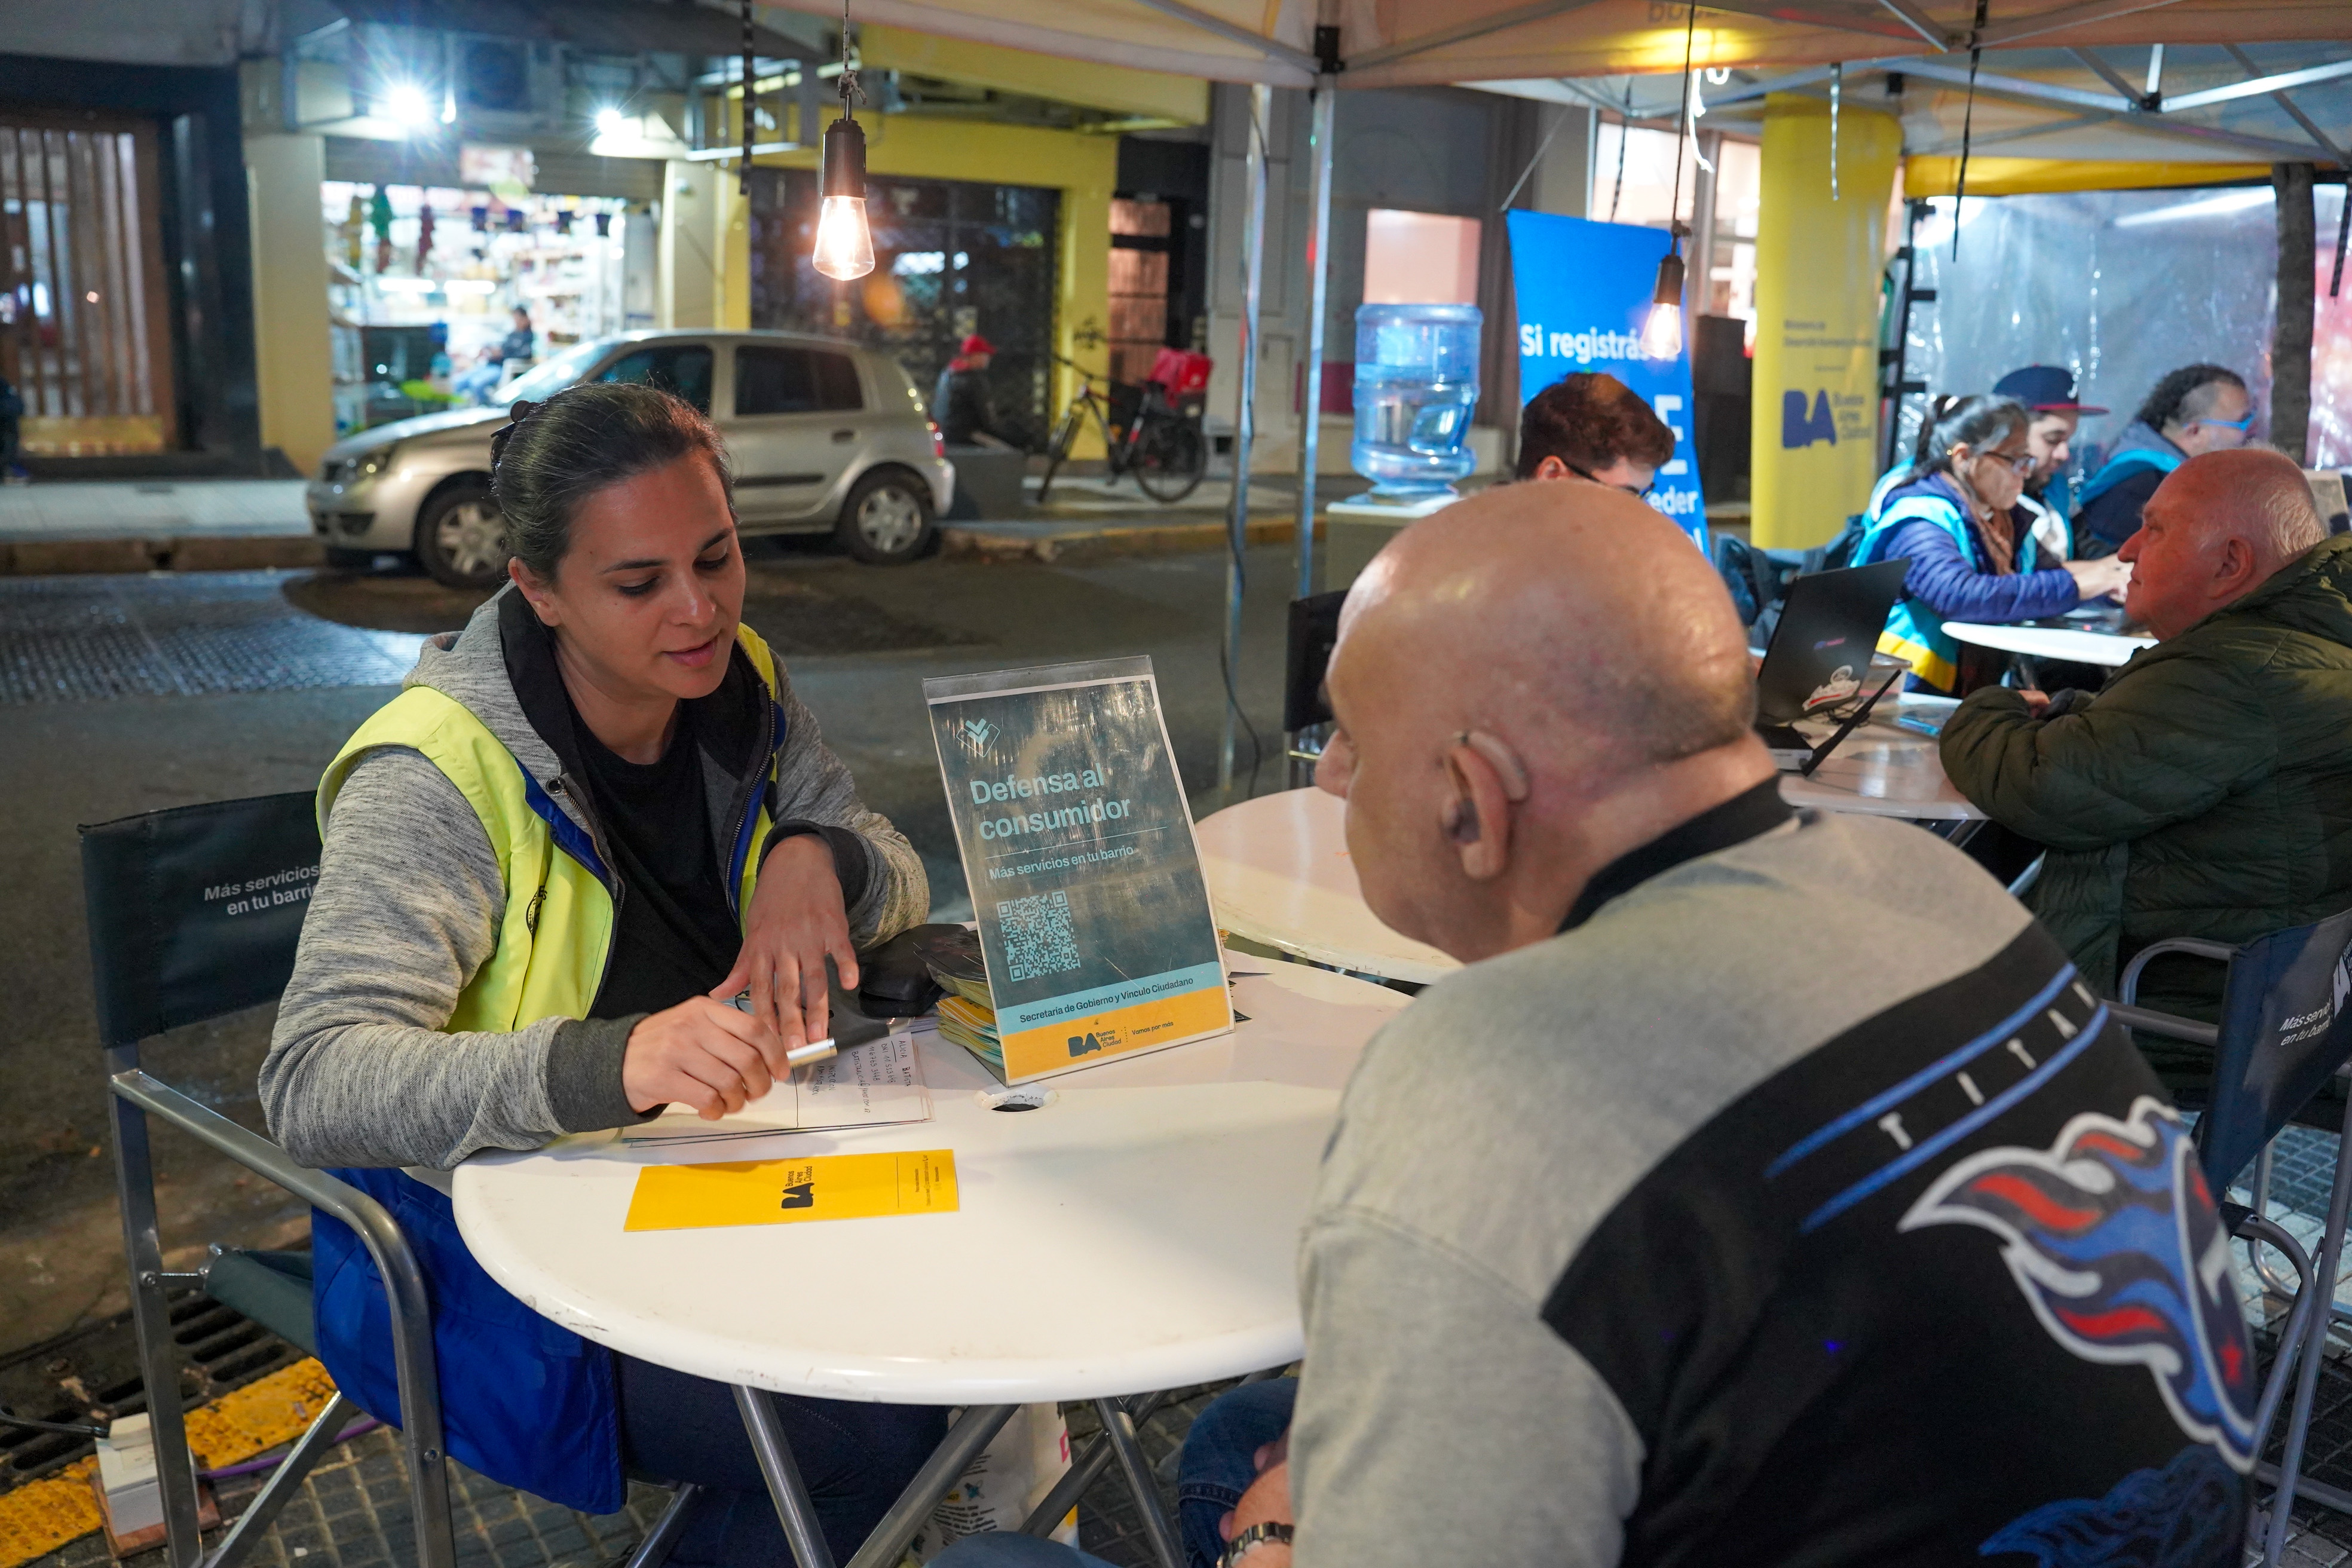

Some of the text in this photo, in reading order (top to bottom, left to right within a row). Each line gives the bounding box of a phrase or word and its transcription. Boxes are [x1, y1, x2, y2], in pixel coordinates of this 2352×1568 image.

[1520, 323, 1544, 357] Si
[1783, 390, 1836, 449] BA
[970, 763, 1105, 804] Defensa al
[979, 797, 1131, 840] consumidor
[989, 845, 1134, 880] Más servicios en tu barrio
[204, 865, 320, 901] Más servicios
[226, 883, 317, 915] en tu barri
[1019, 978, 1193, 1023] Secretaría de Gobierno y Vínculo Ciudadano
[1132, 1027, 1150, 1035] Vamos
[2279, 1014, 2304, 1031] Más
[2280, 1033, 2298, 1046] en
[2295, 1030, 2310, 1042] tu
[1068, 1029, 1116, 1057] BA Buenos
[1102, 1039, 1122, 1048] Ciudad
[781, 1171, 814, 1209] BA Buenos
[795, 1171, 803, 1183] Aires
[803, 1166, 813, 1182] Ciudad
